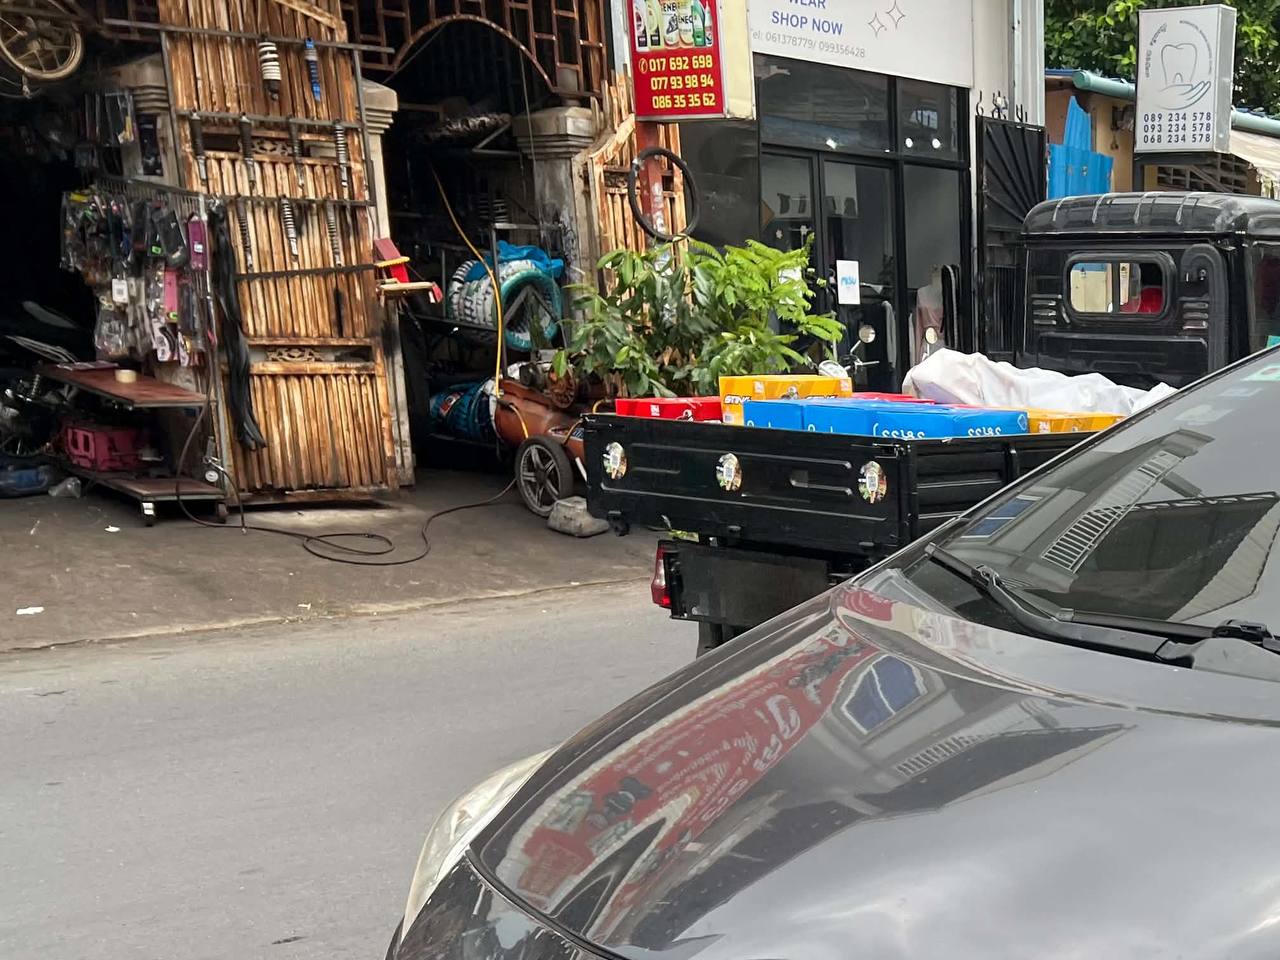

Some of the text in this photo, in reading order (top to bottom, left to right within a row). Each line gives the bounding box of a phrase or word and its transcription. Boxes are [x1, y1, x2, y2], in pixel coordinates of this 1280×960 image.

[771, 11, 843, 36] SHOP NOW
[649, 54, 713, 72] 017 692 698
[650, 73, 714, 91] 077 93 98 94
[652, 92, 716, 109] 086 35 35 62
[1143, 112, 1211, 123] 089 234 578
[1143, 122, 1211, 133] 093 234 578
[1143, 133, 1211, 143] 068 234 578
